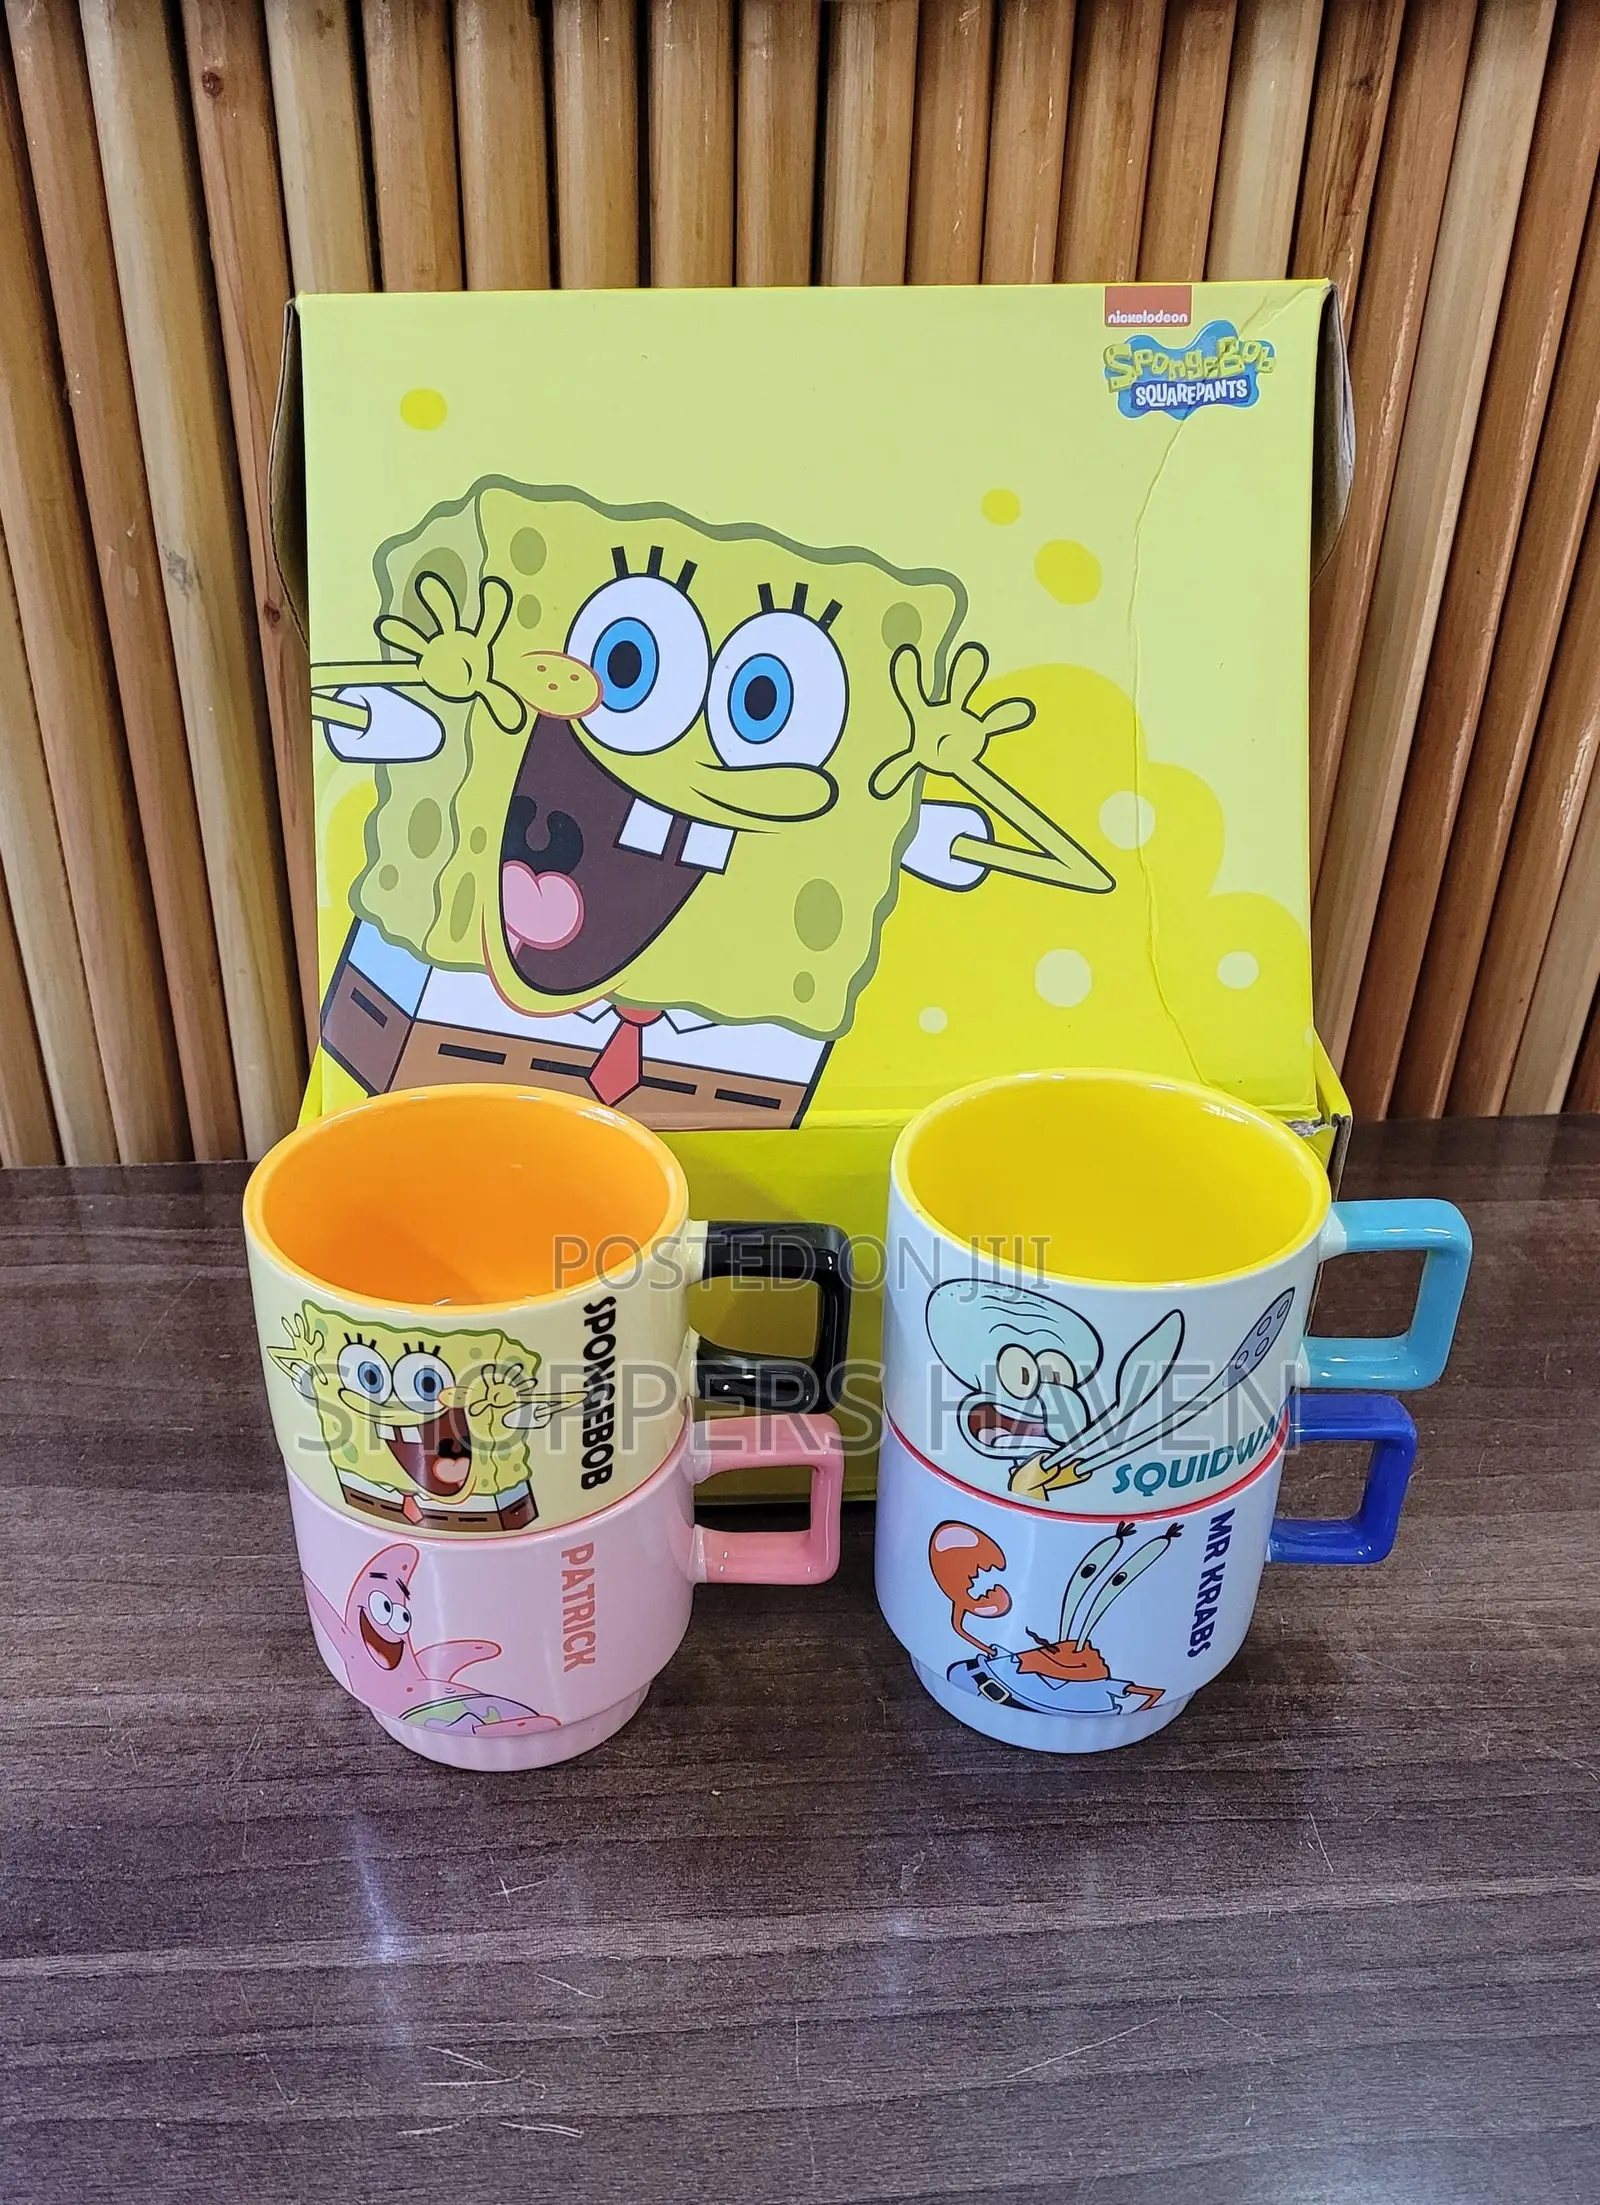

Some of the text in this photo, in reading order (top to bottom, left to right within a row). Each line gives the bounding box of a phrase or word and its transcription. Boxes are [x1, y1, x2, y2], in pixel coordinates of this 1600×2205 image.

[1107, 309, 1188, 324] nickelodeon
[1135, 378, 1248, 407] SQUAREPANTS
[581, 1296, 617, 1490] SPONGEBOB
[1112, 1402, 1287, 1497] SQUIDWA
[561, 1542, 596, 1673] PATRICK
[1187, 1508, 1236, 1658] MR KRABS
